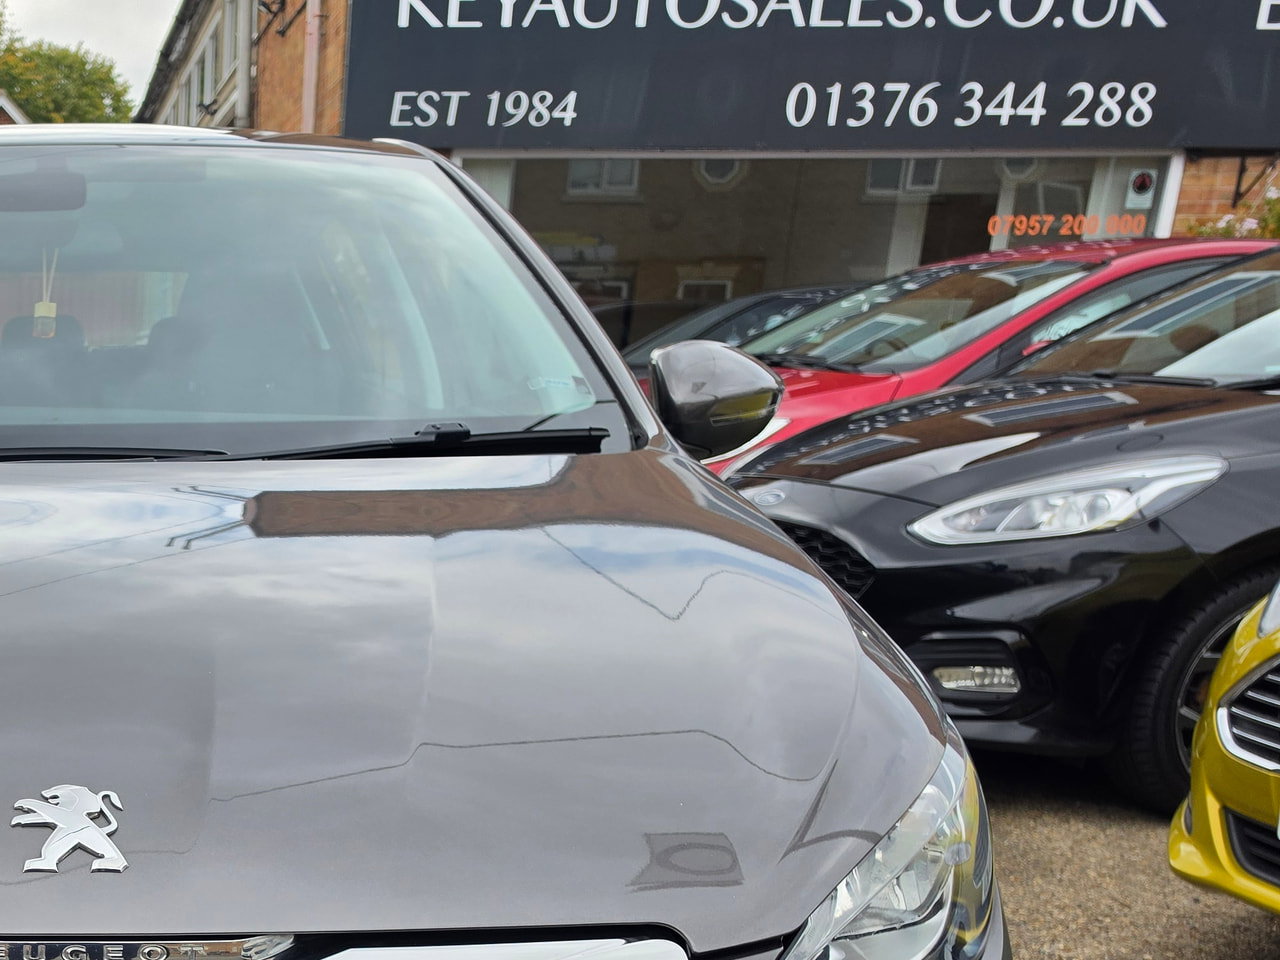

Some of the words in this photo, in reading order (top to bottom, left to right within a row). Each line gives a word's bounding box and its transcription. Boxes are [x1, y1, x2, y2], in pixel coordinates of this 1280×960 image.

[389, 90, 471, 127] EST
[486, 90, 577, 127] 1984
[785, 81, 942, 128] 01376
[954, 81, 1047, 127] 344
[1060, 81, 1157, 128] 288
[987, 214, 1055, 236] 07957
